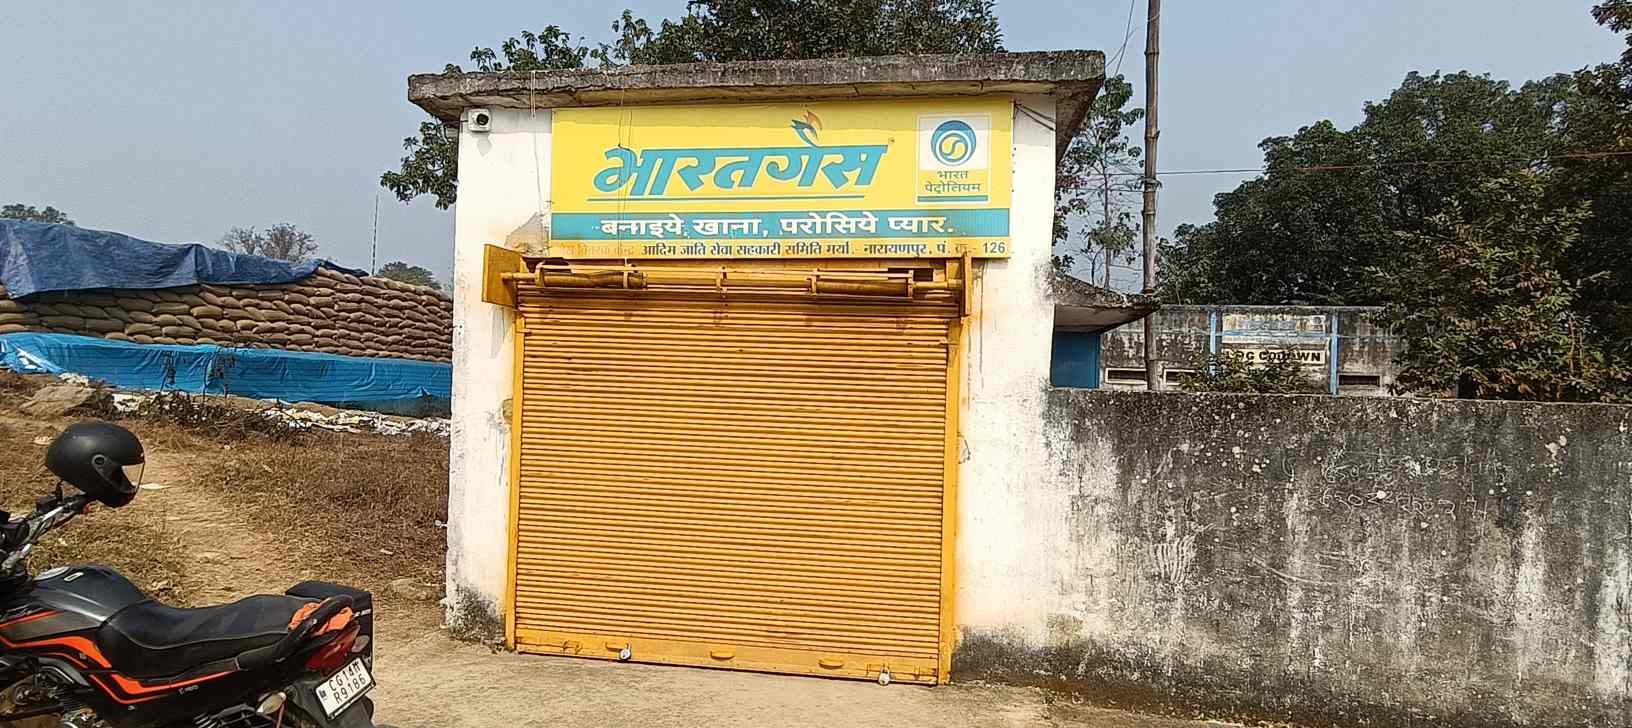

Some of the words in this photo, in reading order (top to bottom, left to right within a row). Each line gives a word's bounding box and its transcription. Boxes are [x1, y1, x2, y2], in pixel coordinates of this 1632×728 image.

[937, 170, 969, 179] भारत
[924, 180, 981, 194] पेट्रोलियम
[692, 218, 770, 237] खाना,
[779, 211, 879, 235] परोसिये
[641, 242, 676, 255] आदिम
[680, 241, 706, 255] जाति
[710, 242, 732, 255] सेवा
[736, 241, 781, 255] सहकारी
[785, 241, 822, 255] समिति
[983, 242, 1006, 254] 126
[333, 673, 366, 704] R9186
